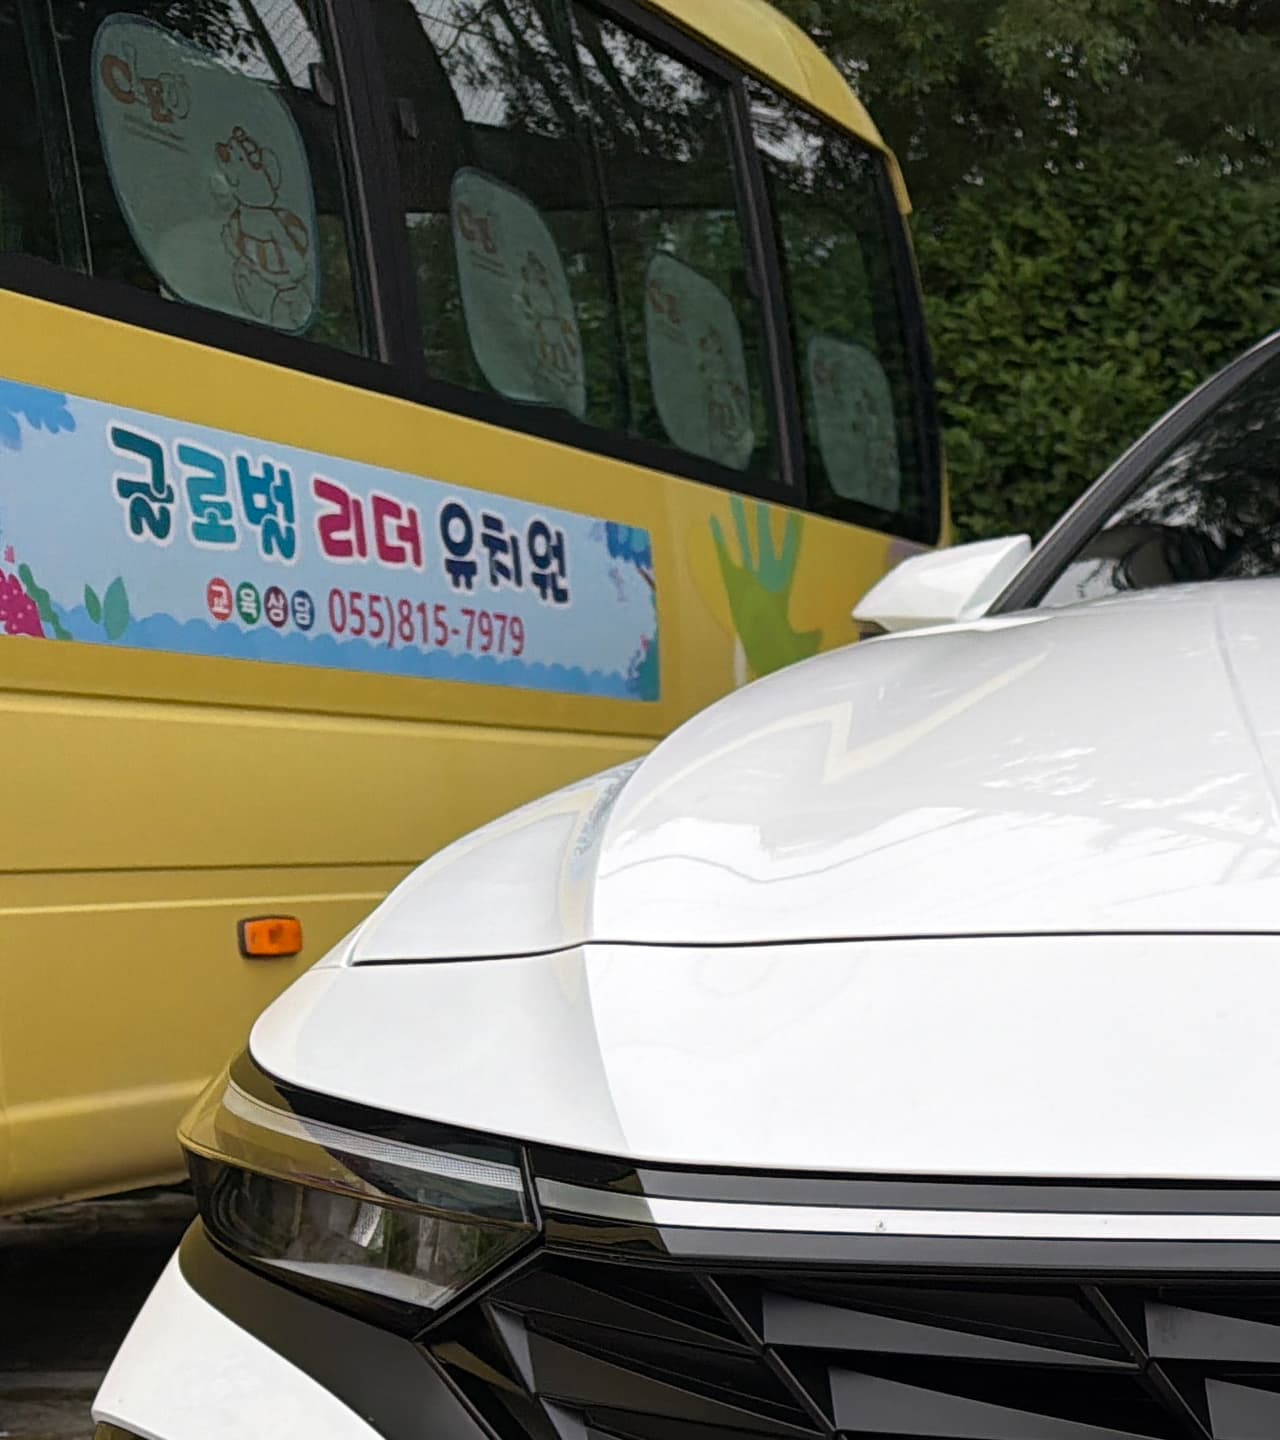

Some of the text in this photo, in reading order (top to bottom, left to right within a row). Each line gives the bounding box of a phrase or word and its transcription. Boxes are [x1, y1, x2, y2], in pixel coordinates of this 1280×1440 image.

[110, 425, 569, 604] 글로벌 리더 유치원
[328, 587, 525, 657] 055)815-7979
